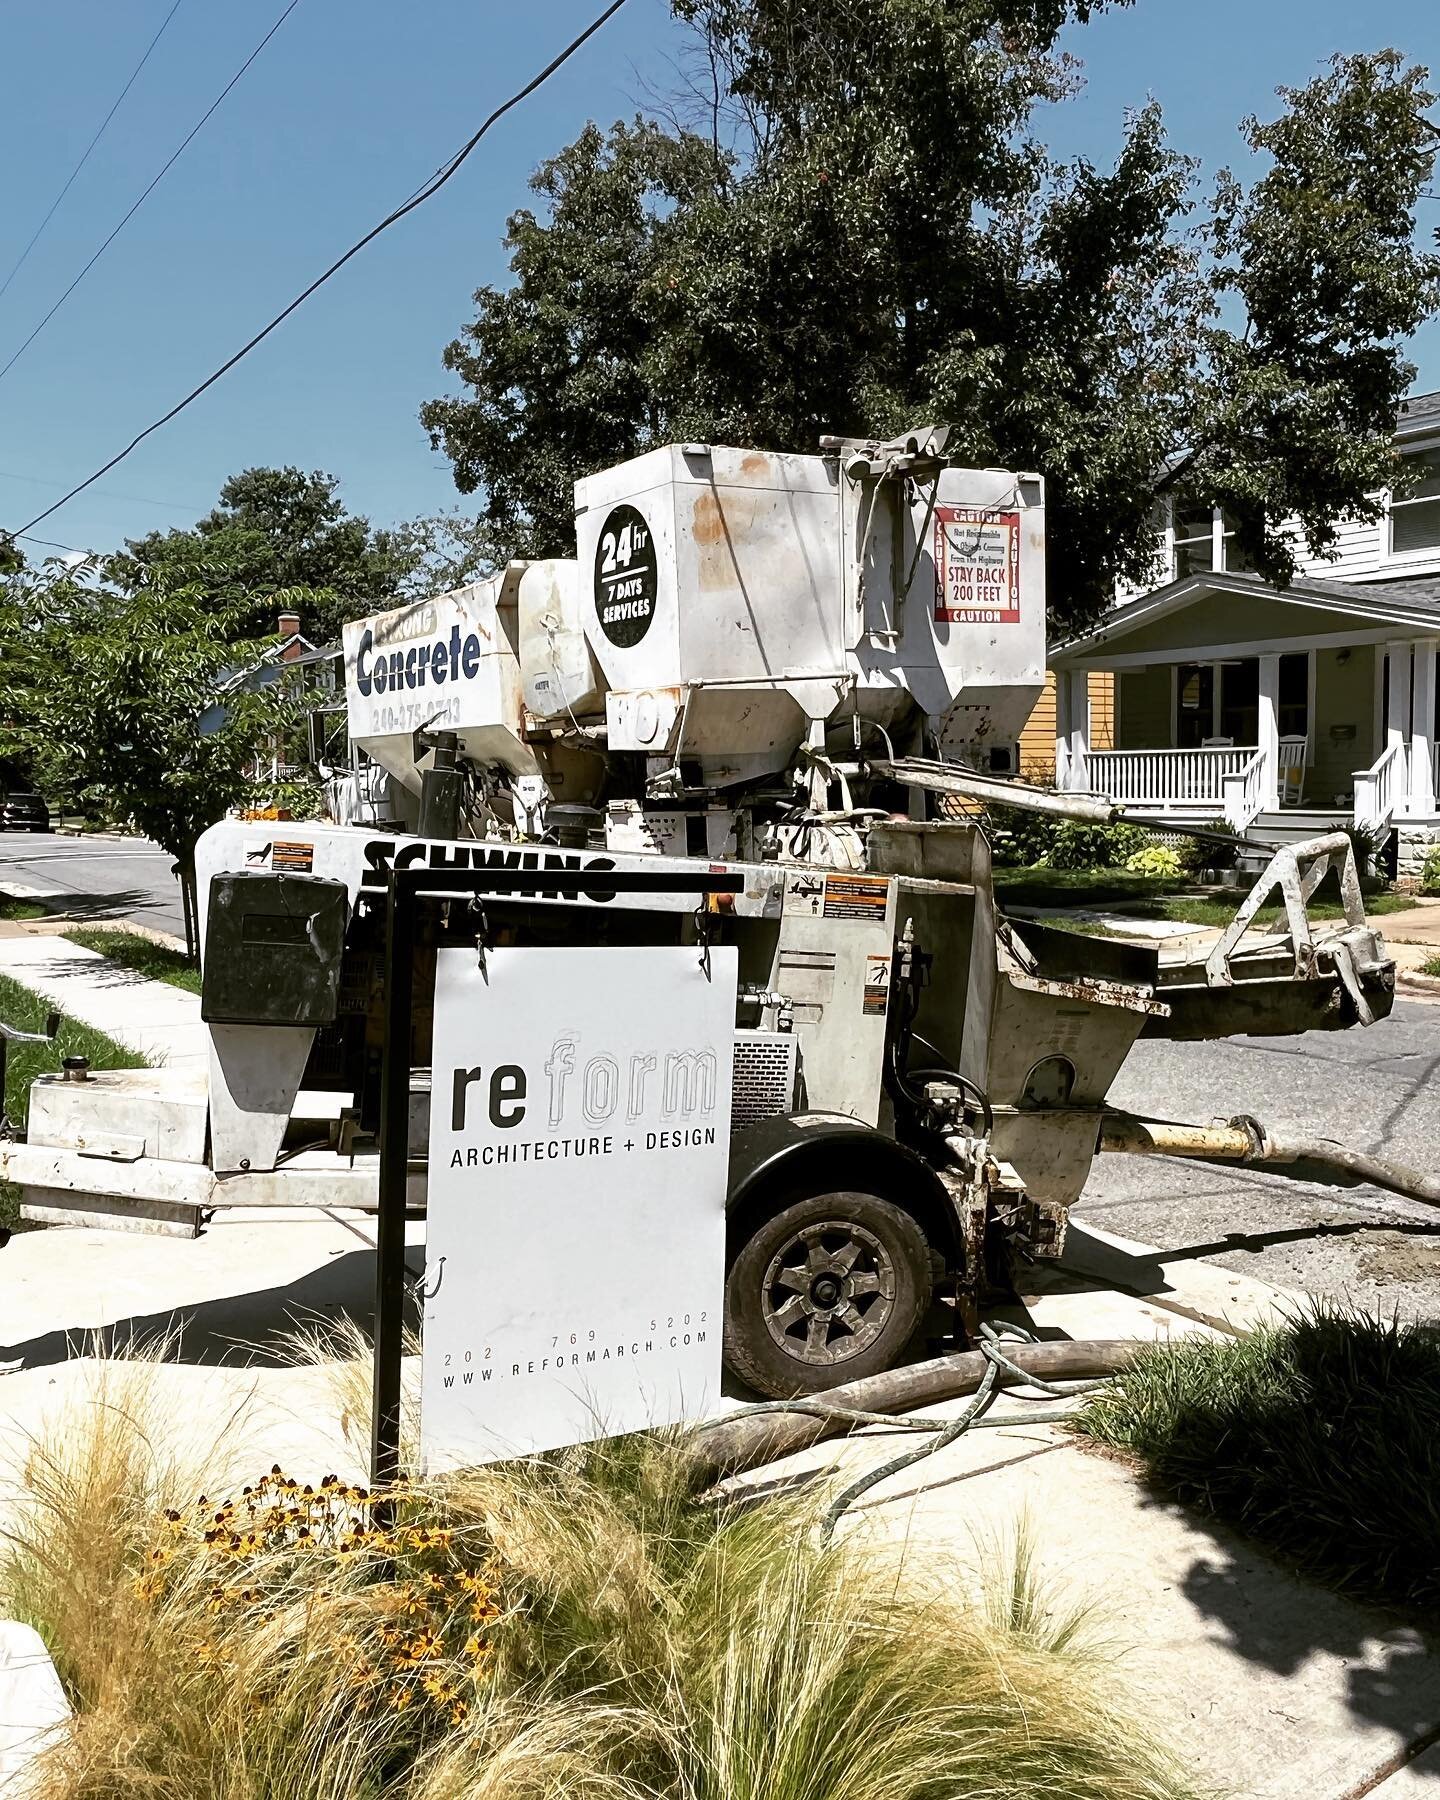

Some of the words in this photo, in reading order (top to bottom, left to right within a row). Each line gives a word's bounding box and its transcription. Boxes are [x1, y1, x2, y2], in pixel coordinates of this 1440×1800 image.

[948, 566, 973, 582] STAY
[976, 567, 1005, 583] BACK
[607, 584, 616, 602] 7
[616, 578, 643, 599] DAYS
[953, 585, 973, 600] 200
[977, 586, 1001, 601] FEET
[603, 599, 650, 624] SERVICES
[953, 610, 1000, 622] CAUTION
[356, 624, 481, 697] Concrete
[449, 1136, 613, 1168] ARCHITECTURE
[646, 1127, 716, 1150] DESIGN
[443, 1331, 706, 1388] WWW.REFORMARCH.COM
